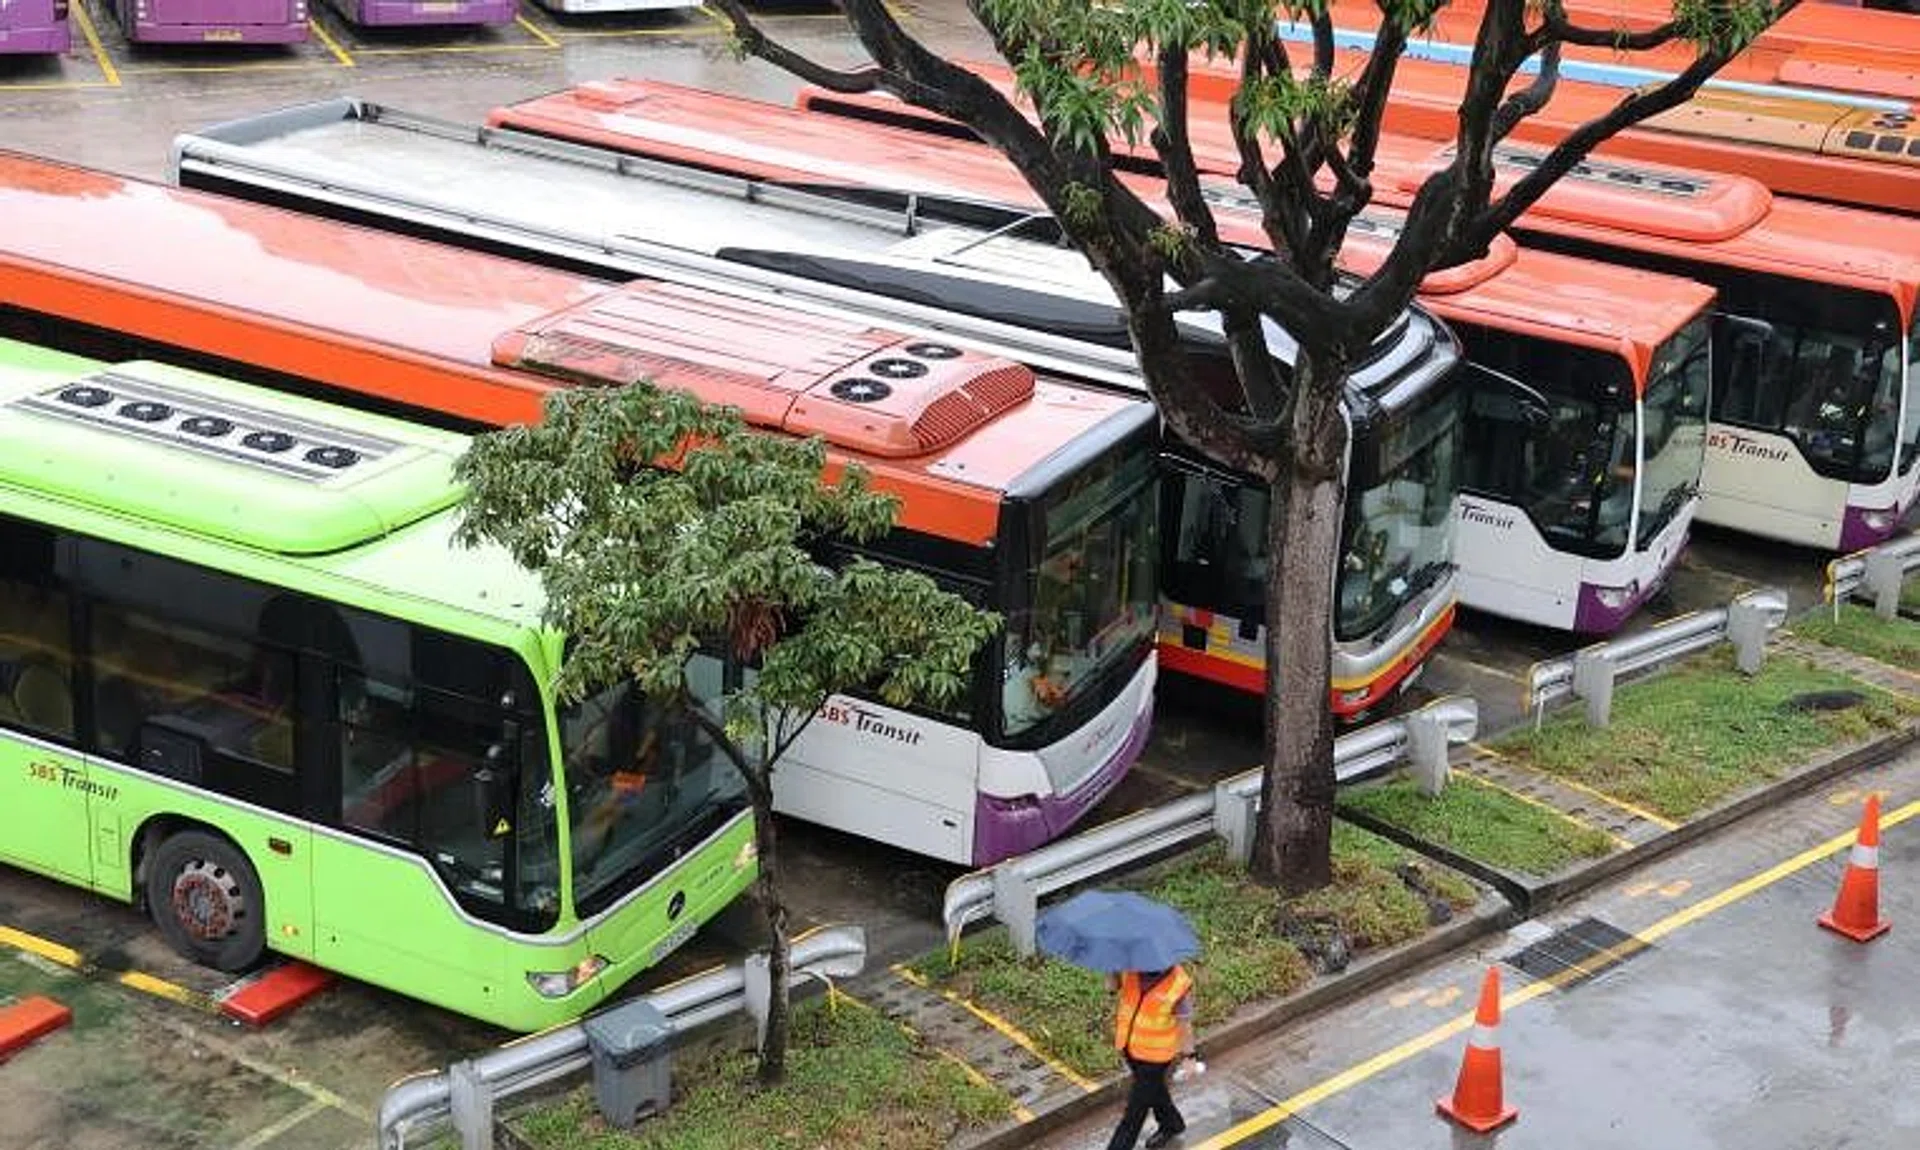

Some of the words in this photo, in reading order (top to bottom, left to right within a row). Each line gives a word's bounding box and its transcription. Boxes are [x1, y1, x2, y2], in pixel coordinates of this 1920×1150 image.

[1730, 433, 1788, 462] Transit
[1460, 502, 1514, 530] Transit
[817, 705, 850, 725] SBS
[855, 708, 921, 745] Transit
[29, 761, 57, 782] SBS
[60, 766, 118, 801] Transit
